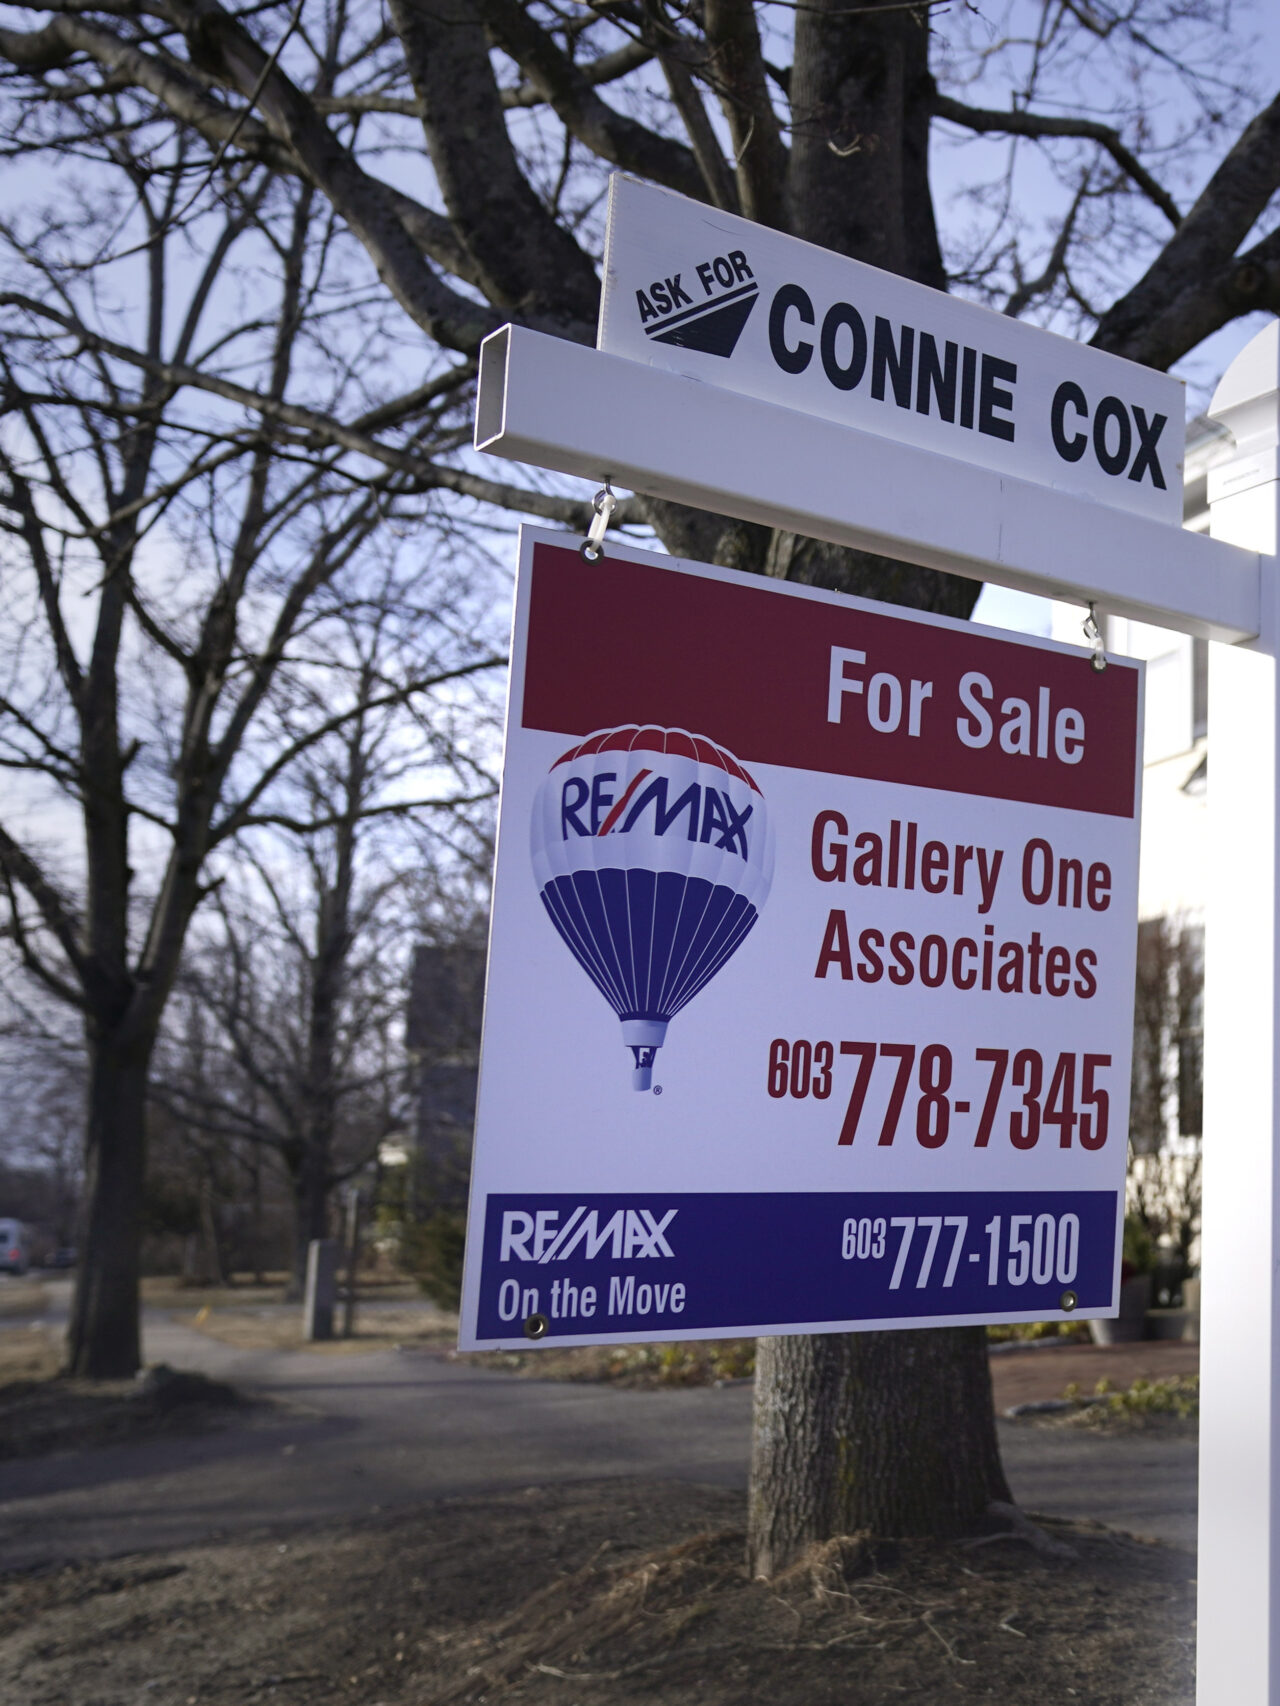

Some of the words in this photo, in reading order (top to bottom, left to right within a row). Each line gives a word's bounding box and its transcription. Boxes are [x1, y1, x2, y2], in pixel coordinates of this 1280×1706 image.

[634, 274, 689, 323] ASK
[695, 249, 754, 296] FOR
[768, 283, 1018, 443] CONNIE
[1050, 380, 1168, 491] COX
[826, 644, 933, 738] For
[956, 671, 1086, 765] Sale
[560, 768, 754, 863] RE/MAX
[810, 809, 1004, 914] Gallery
[1021, 837, 1113, 912] One
[814, 908, 1098, 999] Associates
[767, 1038, 834, 1099] 603
[837, 1040, 1113, 1151] 778-7345
[500, 1206, 679, 1264] RE/MAX
[841, 1217, 887, 1261] 603
[888, 1212, 1080, 1290] 777-1500
[498, 1278, 540, 1321] On
[550, 1277, 597, 1318] the
[607, 1276, 687, 1316] Move
